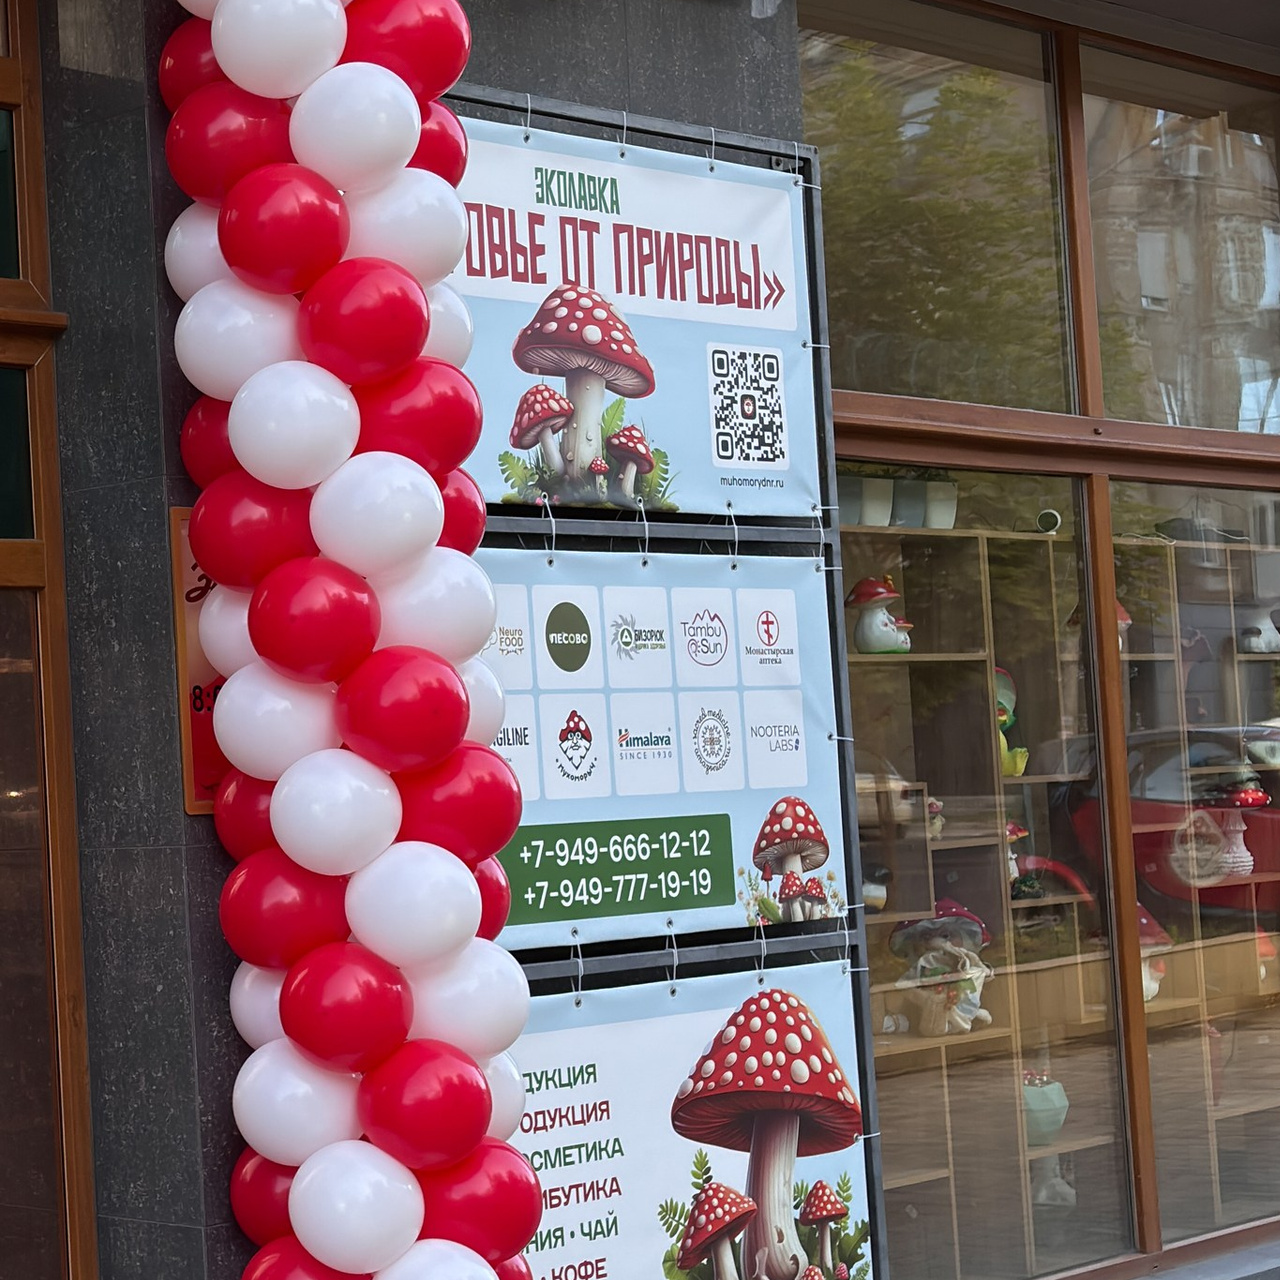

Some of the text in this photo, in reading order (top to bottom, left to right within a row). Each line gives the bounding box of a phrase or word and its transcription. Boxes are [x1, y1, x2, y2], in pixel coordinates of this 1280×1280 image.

[534, 166, 620, 215] ЭКОЛАВКА
[463, 201, 786, 310] ОВЬЕ ОТ ПРИРОДЫ»
[720, 475, 784, 490] muhomorydnr.ru
[499, 626, 523, 636] Neuro
[634, 628, 665, 642] БИЗОРЮК
[680, 621, 722, 638] Tambu
[499, 636, 524, 647] FOOD
[700, 638, 723, 655] Sun
[745, 646, 794, 657] Монастырская
[759, 657, 782, 665] аптека
[493, 727, 529, 747] GILINE
[618, 728, 671, 748] Himalaya
[750, 724, 800, 738] NOOTERIA
[770, 739, 794, 752] LABS
[619, 751, 673, 760] SINCE 1930
[520, 829, 711, 868] +7-949-666-12-12
[524, 868, 712, 909] +7-949-777-19-19
[522, 1063, 597, 1094] ДУКЦИЯ
[520, 1100, 610, 1134] ОДУКЦИЯ
[523, 1137, 624, 1172] СМЕТИКА
[523, 1210, 618, 1254] НИЯ ЧАЙ
